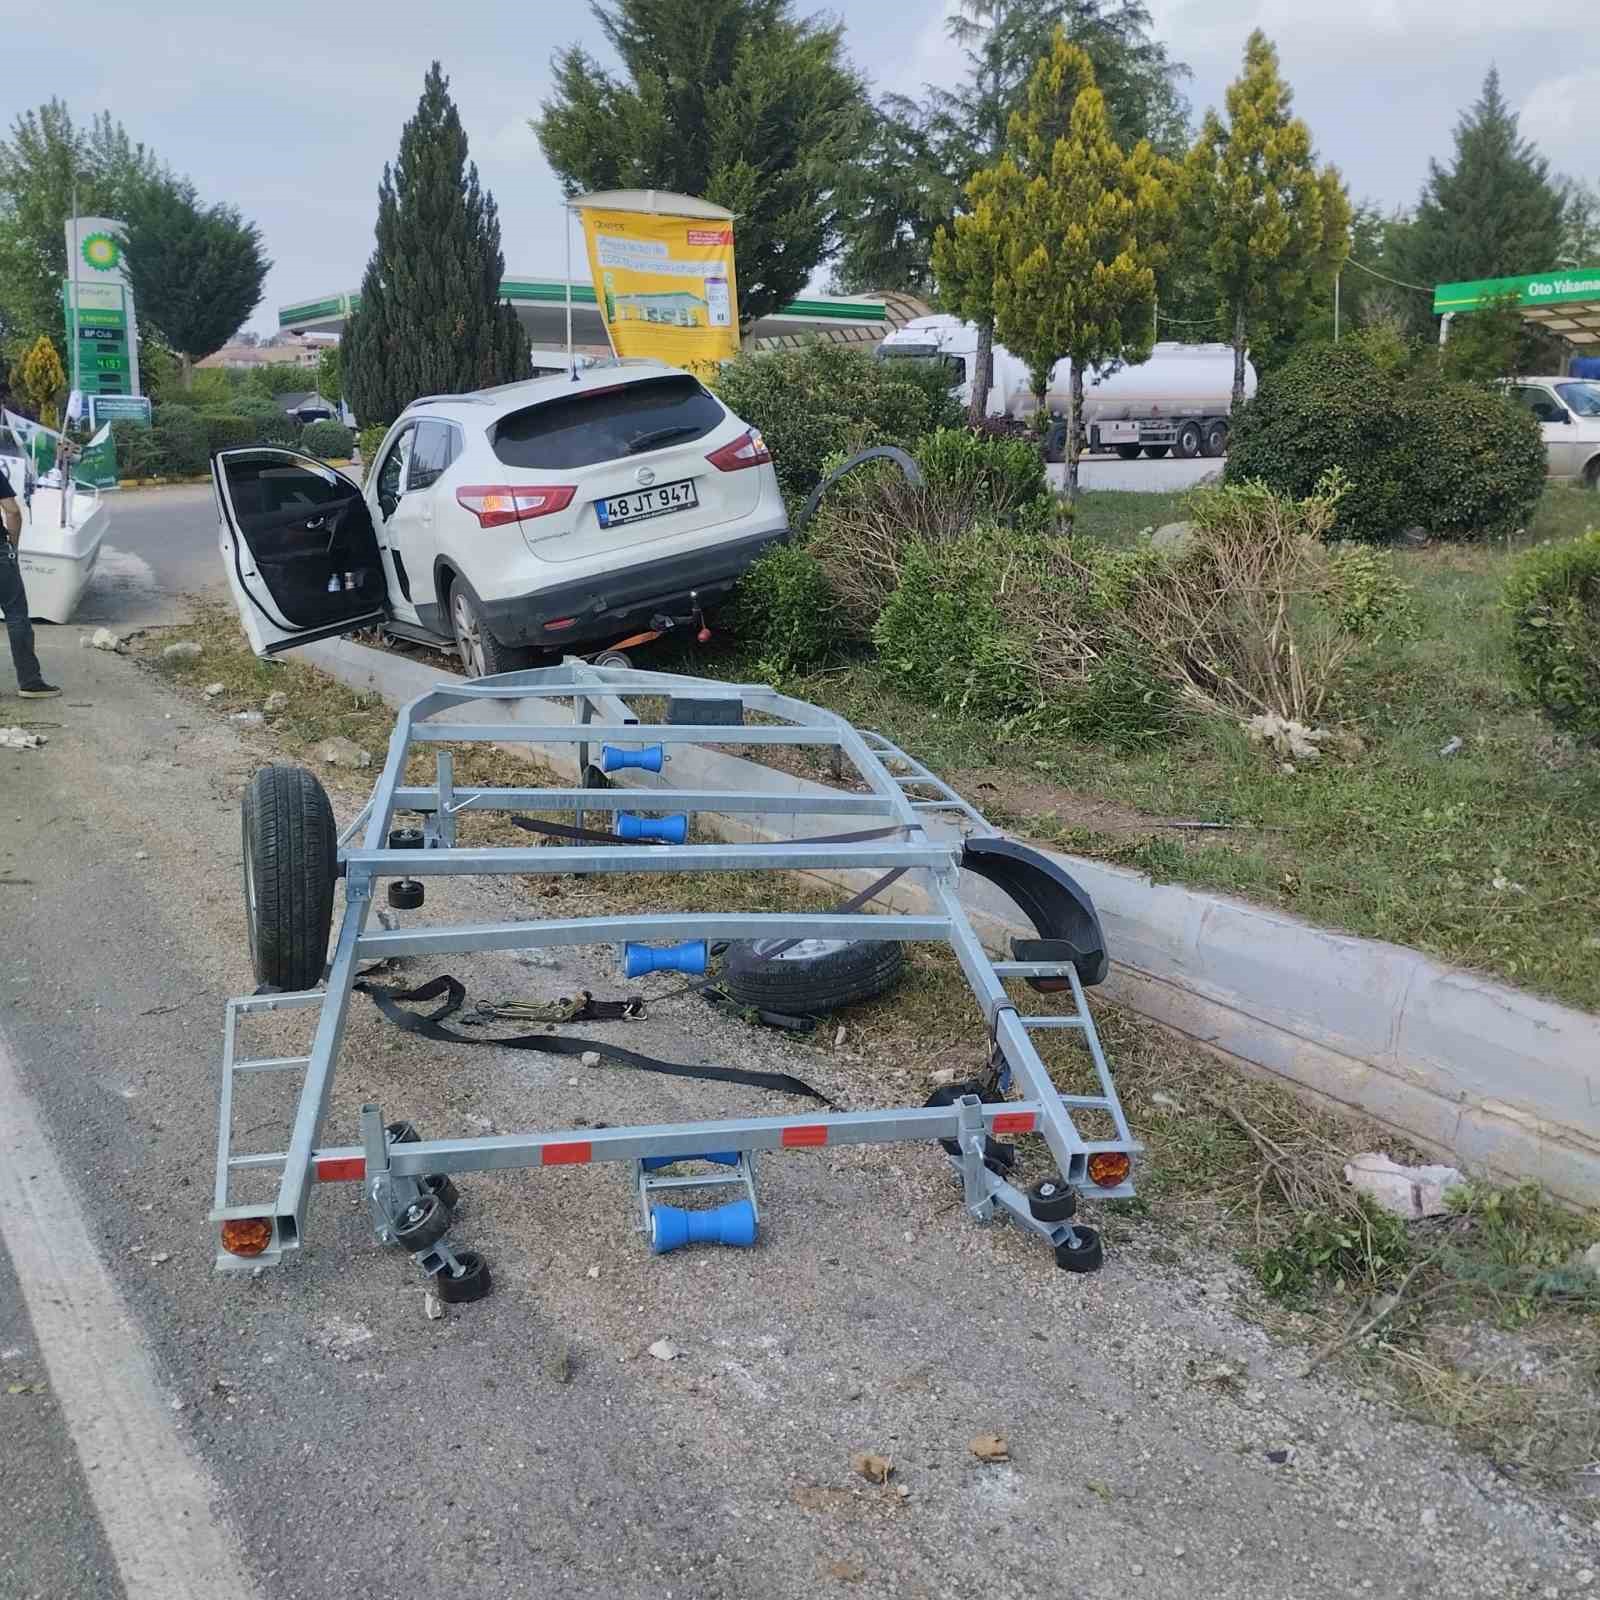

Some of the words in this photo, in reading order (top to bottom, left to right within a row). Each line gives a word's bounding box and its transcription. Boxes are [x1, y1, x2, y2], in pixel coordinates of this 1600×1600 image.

[1528, 282, 1552, 297] Oto
[608, 499, 629, 517] 48
[634, 493, 653, 512] JT
[659, 484, 690, 506] 947
